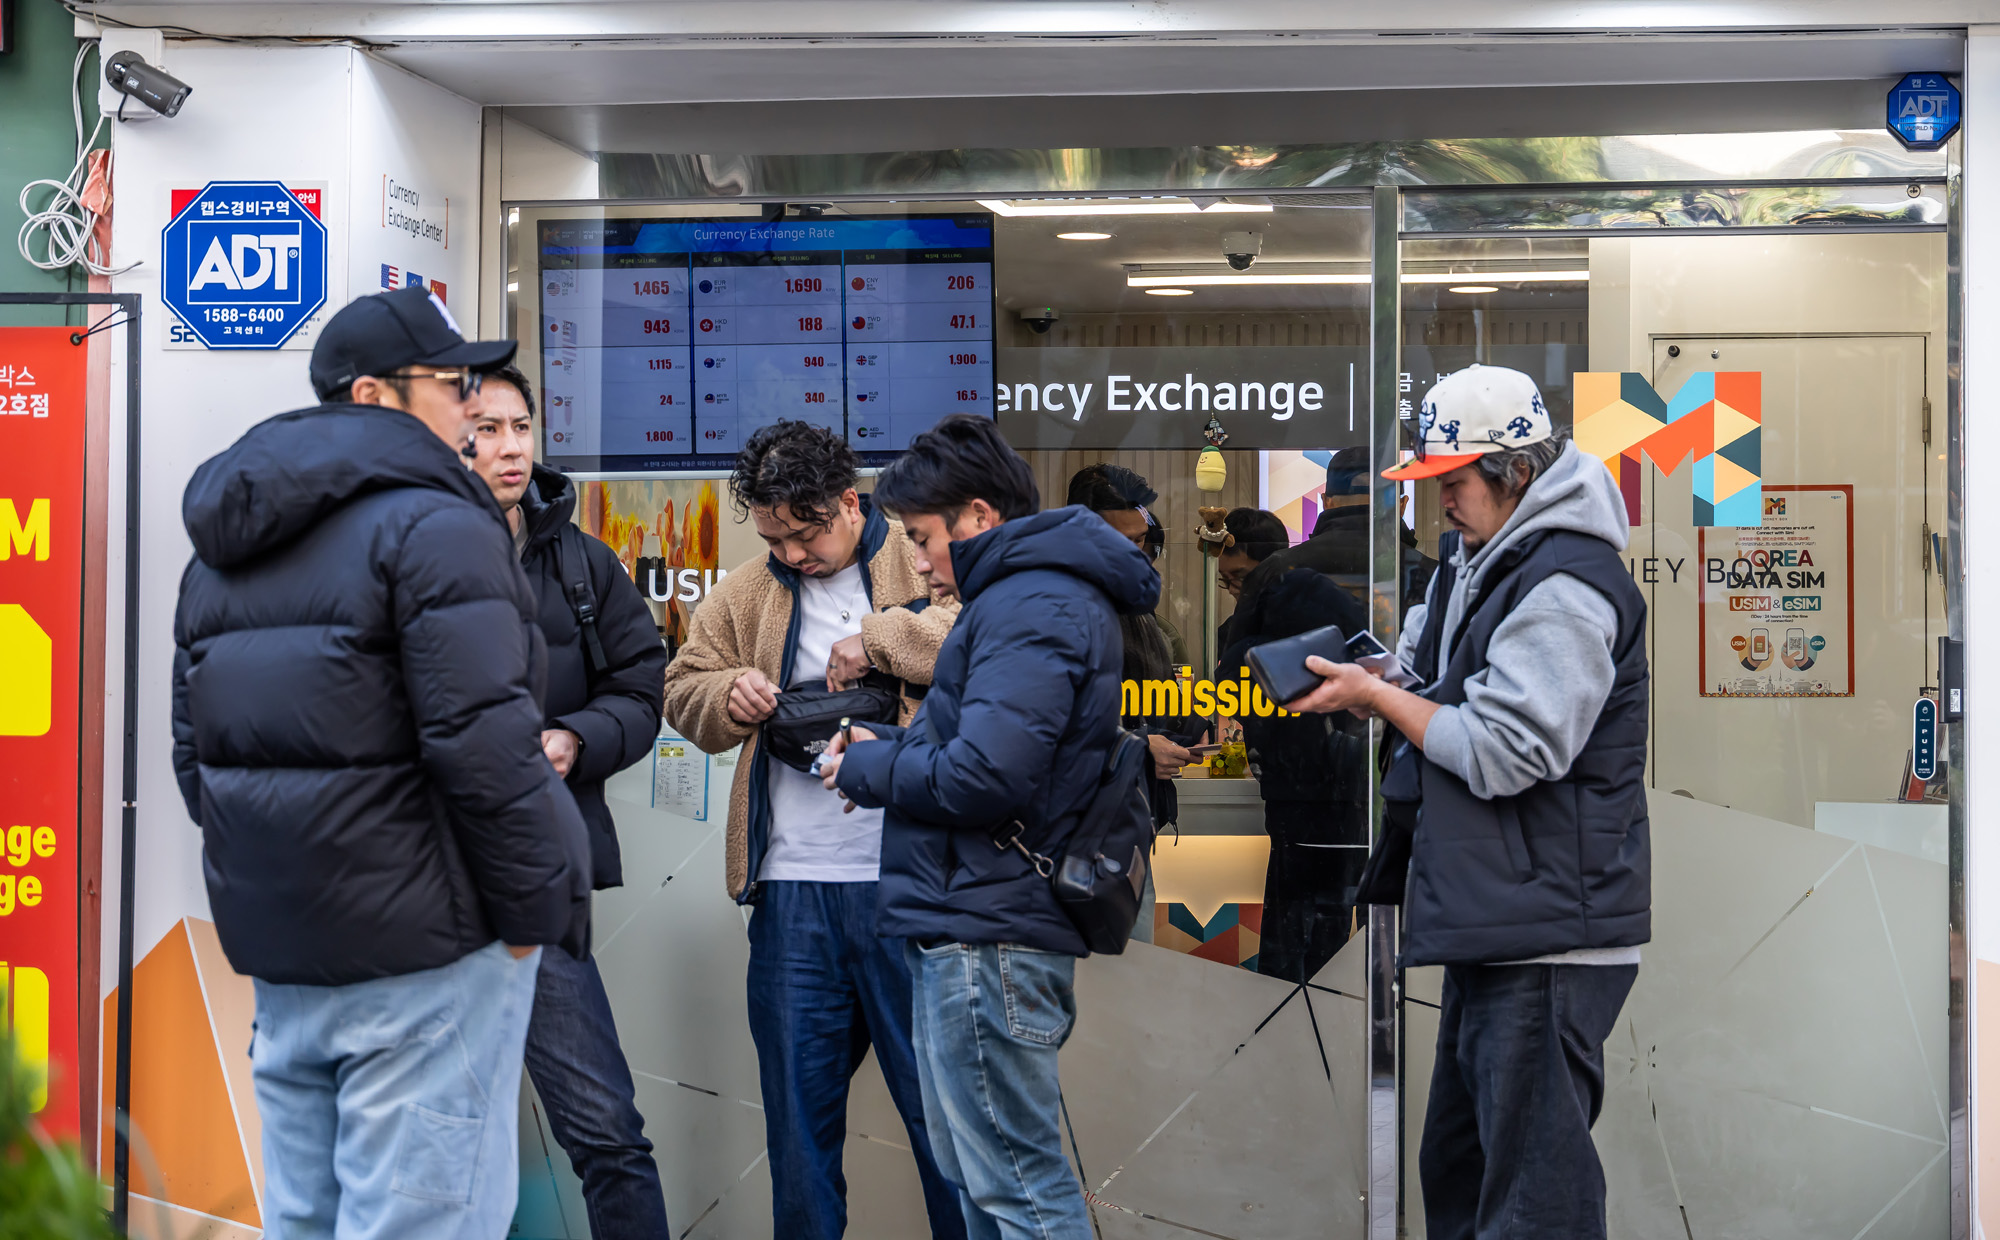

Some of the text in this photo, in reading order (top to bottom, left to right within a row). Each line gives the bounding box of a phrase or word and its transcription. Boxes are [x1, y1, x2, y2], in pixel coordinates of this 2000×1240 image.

[1900, 95, 1948, 118] ADT
[298, 193, 317, 204] 안심
[388, 179, 420, 212] Currency
[200, 200, 290, 216] 캡스경비구역
[388, 206, 443, 243] Exchange Center
[694, 227, 836, 242] Currency Exchange Rate
[189, 234, 300, 291] ADT
[633, 280, 670, 296] 1,465
[785, 278, 822, 294] 1,690
[947, 275, 975, 290] 206
[204, 308, 284, 322] 1588-6400
[950, 314, 976, 329] 47.1
[223, 326, 264, 335] 고객센터
[644, 319, 671, 334] 943
[798, 317, 823, 331] 188
[648, 358, 672, 370] 1,115
[804, 356, 824, 367] 940
[949, 353, 977, 366] 1,900
[660, 395, 673, 406] 24
[805, 392, 825, 403] 340
[956, 390, 977, 401] 16.5
[1107, 374, 1324, 421] Exchange
[646, 431, 674, 443] 1,800
[1738, 549, 1814, 567] KOREA
[1707, 558, 1779, 583] BOX
[1726, 571, 1825, 589] DATA SIM
[1732, 598, 1819, 610] USIM & eSIM
[1118, 666, 1301, 717] mmissio
[0, 825, 57, 867] ge
